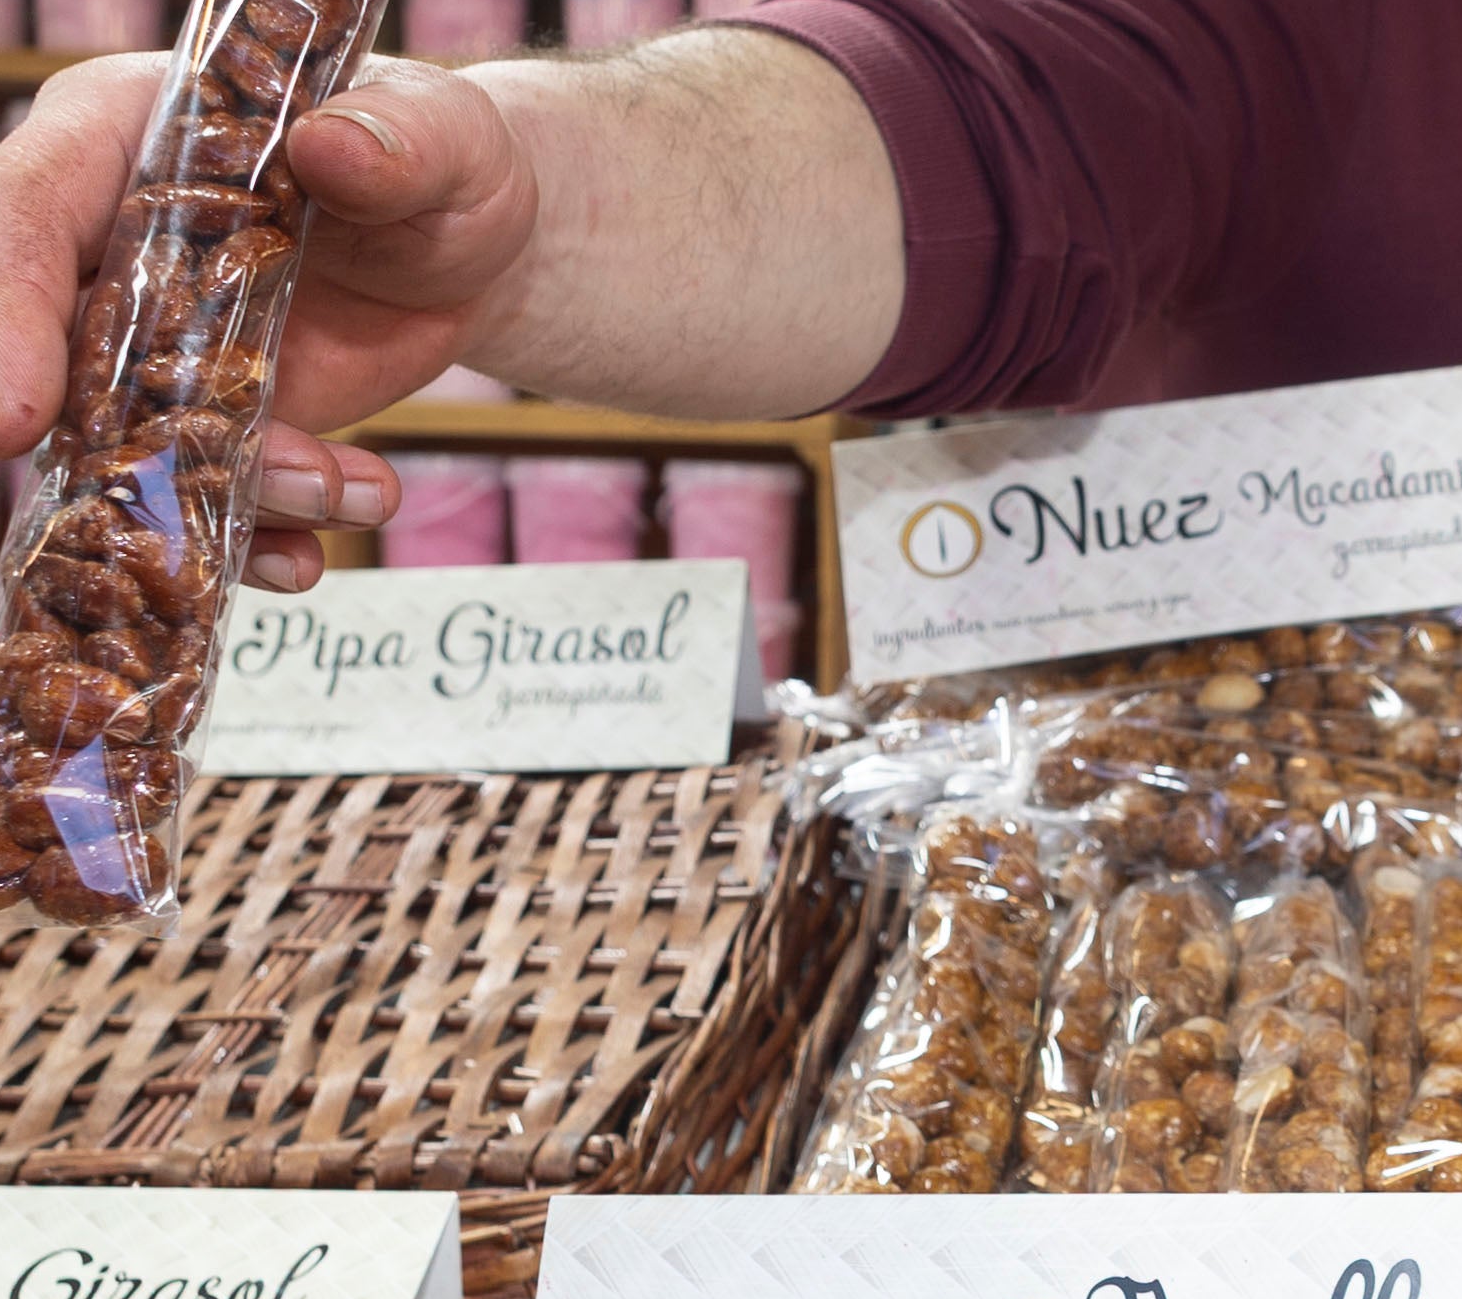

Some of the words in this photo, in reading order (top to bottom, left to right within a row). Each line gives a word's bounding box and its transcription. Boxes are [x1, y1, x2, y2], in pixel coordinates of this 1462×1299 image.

[990, 476, 1224, 565] Nuez
[232, 608, 414, 698] Pipa
[432, 589, 690, 698] Girasol
